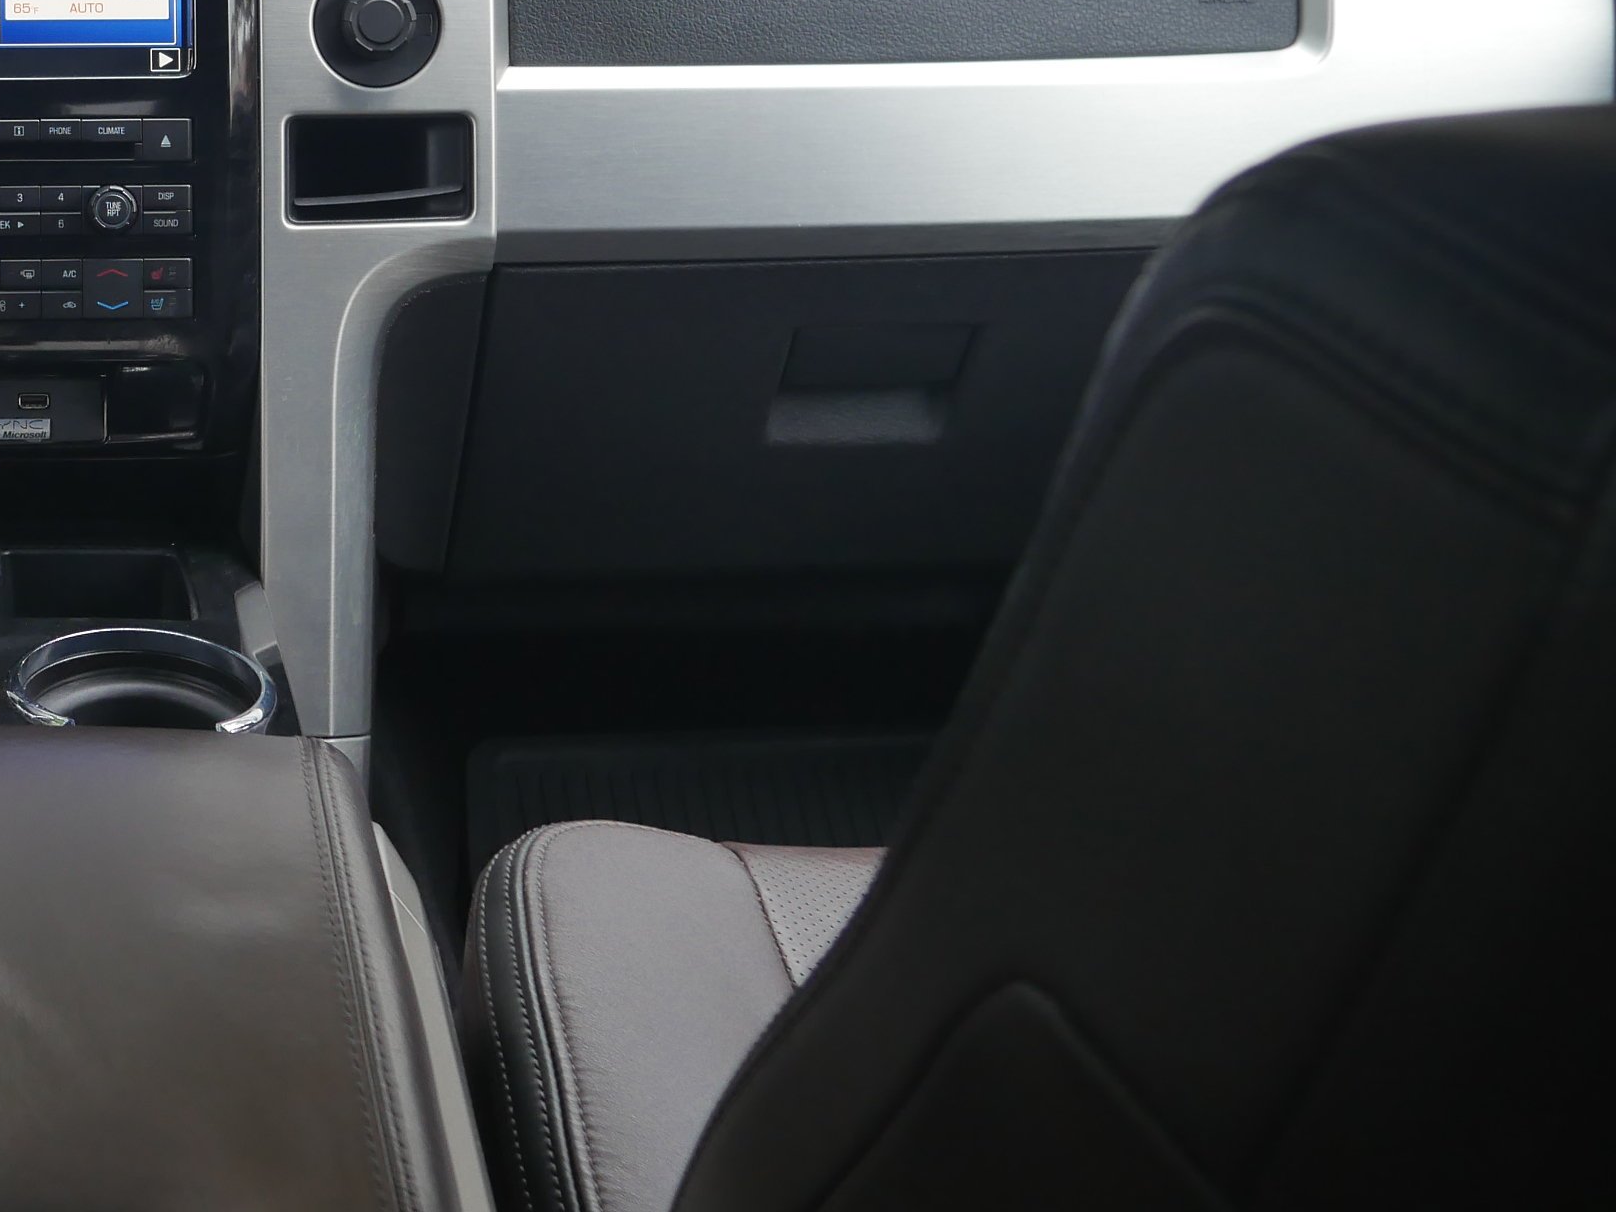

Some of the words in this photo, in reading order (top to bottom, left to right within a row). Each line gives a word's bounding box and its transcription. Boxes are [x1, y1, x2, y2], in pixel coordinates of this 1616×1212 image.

[69, 2, 104, 14] AUTO
[48, 126, 72, 135] PHONE
[98, 126, 126, 135] CLIMATE
[16, 193, 24, 203] 3
[57, 192, 64, 202] 4
[158, 192, 175, 200] DISP
[105, 201, 122, 210] TUNE
[106, 209, 121, 217] RPT
[58, 220, 65, 229] 6
[153, 218, 179, 228] SOUND
[62, 270, 77, 278] A/C
[2, 430, 47, 439] Microsoft
